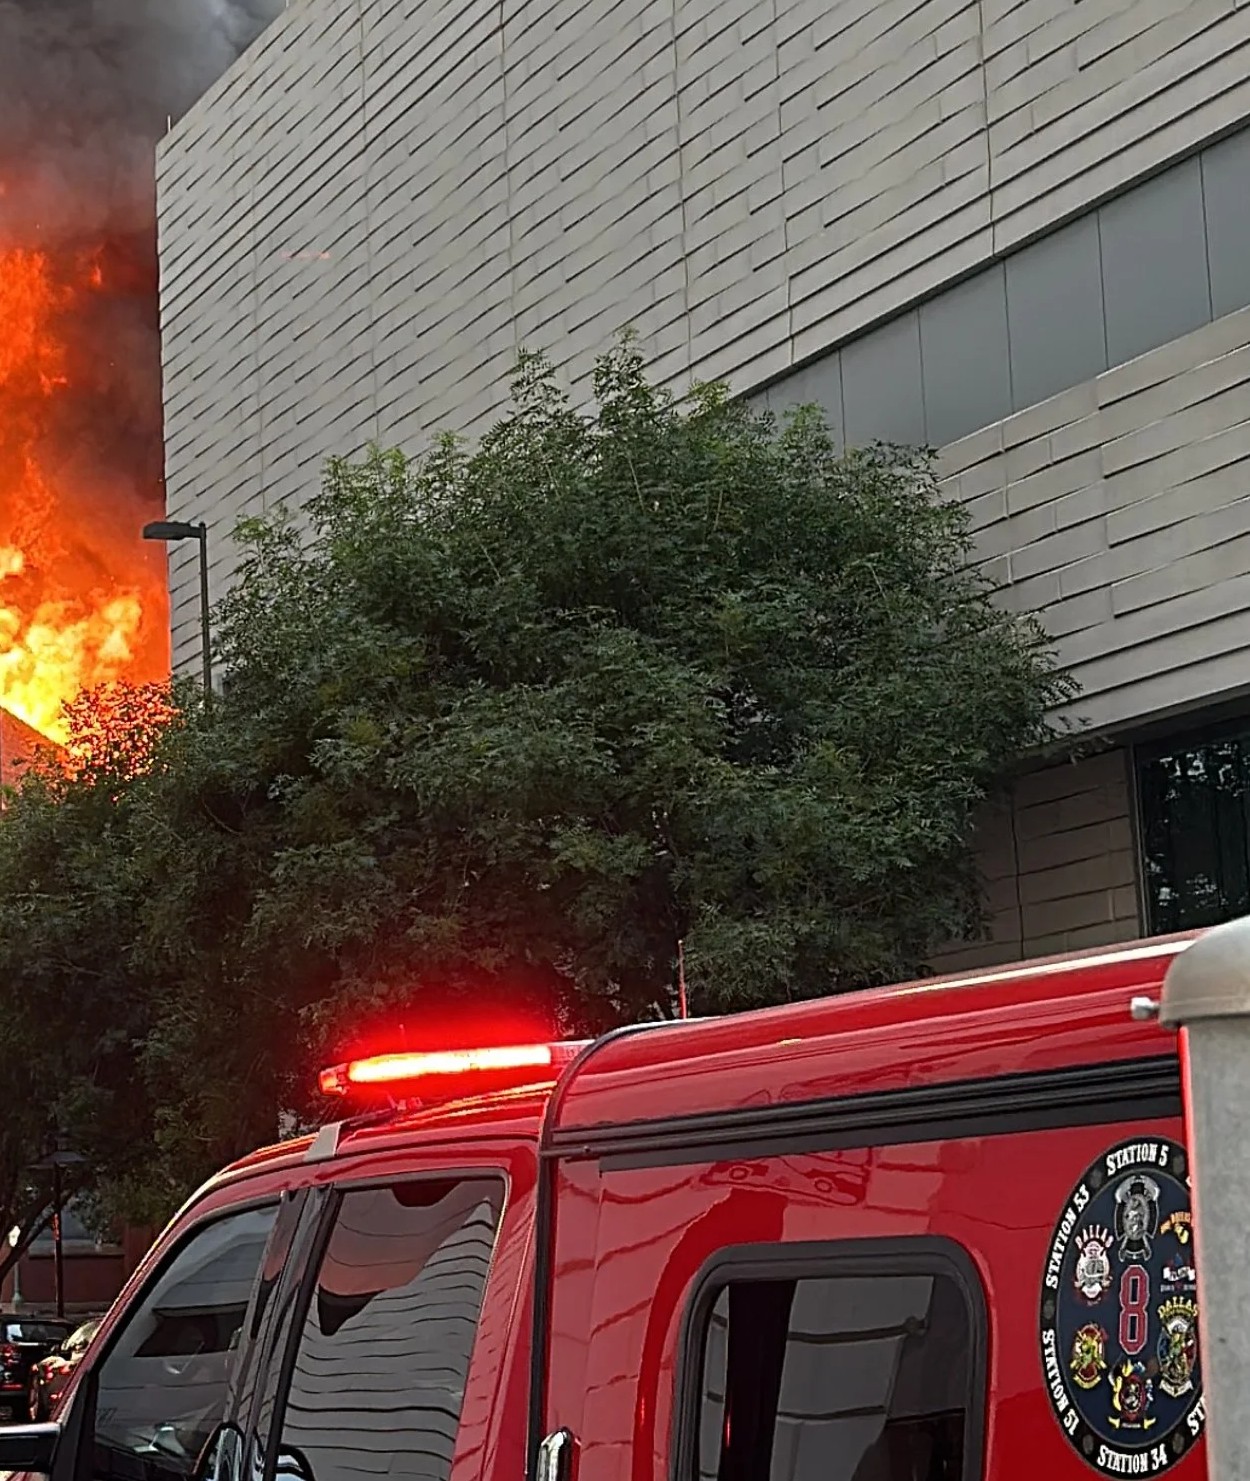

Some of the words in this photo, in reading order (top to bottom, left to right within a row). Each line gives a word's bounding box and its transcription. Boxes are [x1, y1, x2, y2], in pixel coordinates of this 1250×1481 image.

[1106, 1143, 1158, 1176] STATION
[1158, 1145, 1170, 1167] 5
[1046, 1207, 1077, 1290] STATION
[1073, 1184, 1090, 1213] 53
[1118, 1264, 1151, 1356] 8
[1042, 1329, 1070, 1413] STATION
[1063, 1408, 1080, 1436] 51
[1097, 1444, 1149, 1474] STATION
[1150, 1442, 1169, 1471] 34
